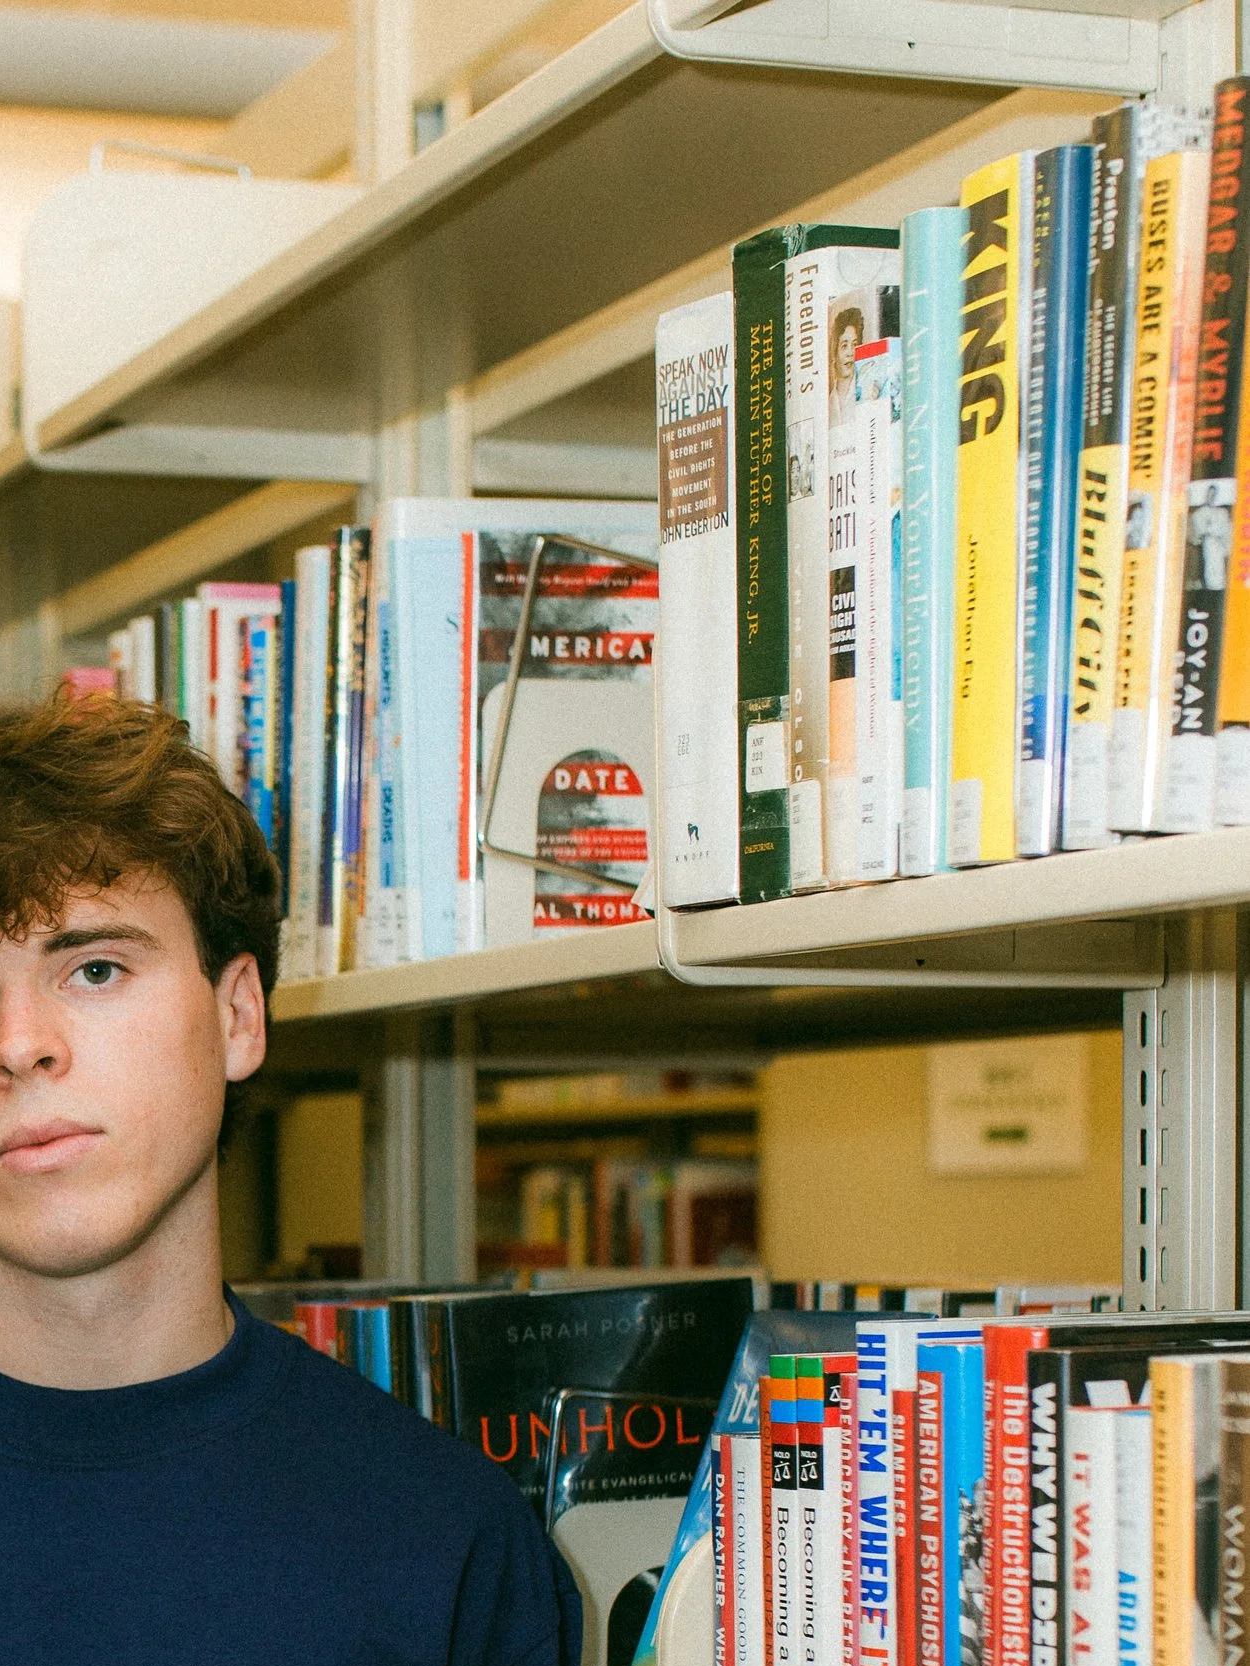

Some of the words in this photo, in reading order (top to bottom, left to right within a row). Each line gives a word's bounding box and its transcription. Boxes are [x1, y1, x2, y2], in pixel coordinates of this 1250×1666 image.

[1207, 88, 1248, 253] MEDGAR
[1103, 158, 1123, 249] Preston
[1146, 179, 1171, 273] BUSES
[1141, 284, 1164, 337] ARE
[1202, 271, 1232, 303] &
[800, 263, 819, 394] Freedom's
[960, 188, 1009, 446] KING
[1031, 287, 1047, 353] NEVER
[659, 355, 694, 385] SPEAK
[699, 344, 728, 370] NOW
[762, 320, 772, 370] THE
[907, 326, 929, 385] Am
[1140, 350, 1161, 367] A
[658, 364, 727, 402] AGAINST
[750, 325, 760, 419] MARTIN
[660, 396, 691, 426] THE
[696, 385, 728, 416] DAY
[761, 378, 772, 464] PAPERS
[1029, 364, 1044, 440] FORGET
[1134, 376, 1159, 478] COMIN'
[662, 429, 675, 443] THE
[677, 416, 722, 439] GENERATION
[670, 445, 698, 461] BEFORE
[700, 438, 713, 452] THE
[907, 404, 930, 472] Not
[668, 464, 688, 480] CIVIL
[690, 457, 715, 474] RIGHTS
[672, 478, 712, 498] MOVEMENT
[750, 431, 759, 528] LUTHER
[761, 474, 772, 505] OF
[1027, 451, 1041, 489] OUR
[660, 523, 682, 546] JOHN
[685, 511, 729, 538] EGERTON
[667, 508, 675, 519] IN
[677, 503, 692, 516] THE
[694, 495, 717, 510] SOUTH
[906, 491, 929, 583] Your
[1026, 501, 1040, 573] PEOPLE
[747, 536, 759, 604] KING,
[965, 533, 977, 651] Jonathan
[747, 611, 759, 644] JR.
[1024, 586, 1038, 637] WERE
[905, 592, 928, 733] Enemy
[677, 734, 690, 745] 323
[751, 737, 764, 747] ANF
[751, 752, 763, 761] 323
[554, 768, 630, 791] DATE
[751, 767, 763, 776] KIN
[675, 850, 711, 862] KNOPF
[744, 842, 775, 855] CALIFORNIA
[506, 1321, 589, 1344] SARAH
[857, 1334, 887, 1395] HIT
[480, 1402, 716, 1462] UNHOL
[1002, 1382, 1029, 1435] The
[774, 1450, 790, 1459] NOLO
[801, 1450, 817, 1459] NOLO
[858, 1408, 887, 1472] 'EM
[919, 1380, 939, 1521] AMERICAN
[1032, 1382, 1058, 1499] WHY
[602, 1472, 694, 1488] EVANGELICAL
[736, 1470, 746, 1505] THE
[841, 1398, 853, 1539] DEMOCRACY
[892, 1413, 907, 1538] SHAMELESS
[1073, 1451, 1091, 1488] IT
[714, 1474, 726, 1518] DAN
[714, 1523, 726, 1606] RATHER
[737, 1513, 748, 1599] COMMON
[860, 1495, 888, 1626] WHERE
[1032, 1502, 1058, 1582] WE
[1073, 1503, 1091, 1591] WAS
[776, 1506, 791, 1638] Becoming
[803, 1507, 818, 1639] Becoming
[738, 1608, 748, 1661] GOOD
[780, 1645, 790, 1661] a
[806, 1647, 816, 1662] a
